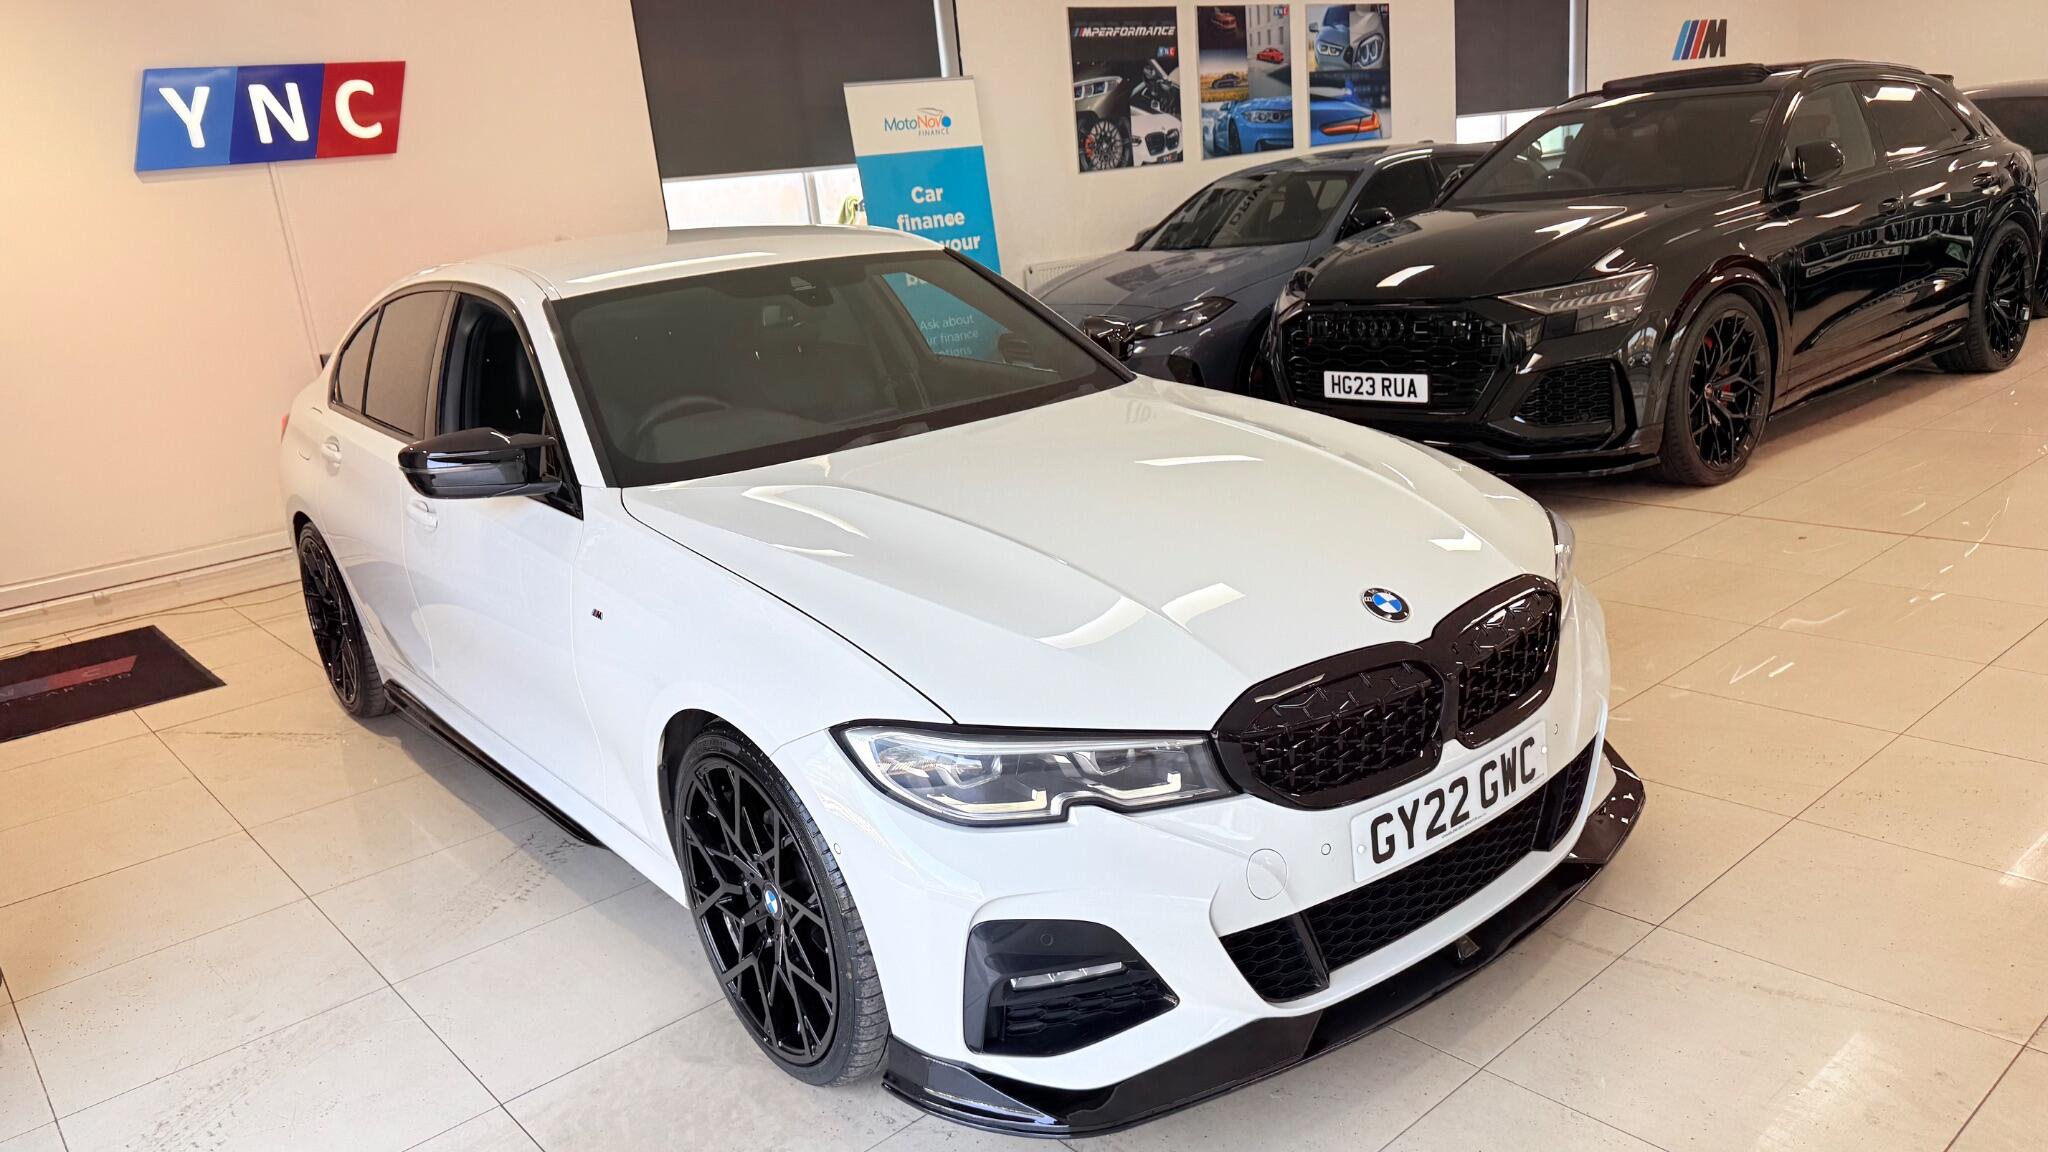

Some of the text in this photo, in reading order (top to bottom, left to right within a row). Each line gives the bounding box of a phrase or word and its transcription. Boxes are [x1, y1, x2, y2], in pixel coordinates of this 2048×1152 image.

[158, 79, 384, 149] YNC
[918, 128, 951, 137] FINANCE
[911, 186, 944, 204] Car
[896, 211, 966, 232] finance
[920, 315, 975, 330] Ask about
[940, 330, 978, 344] finance
[1331, 374, 1418, 398] HG23 RUA
[1371, 736, 1537, 864] GY22 GWC
